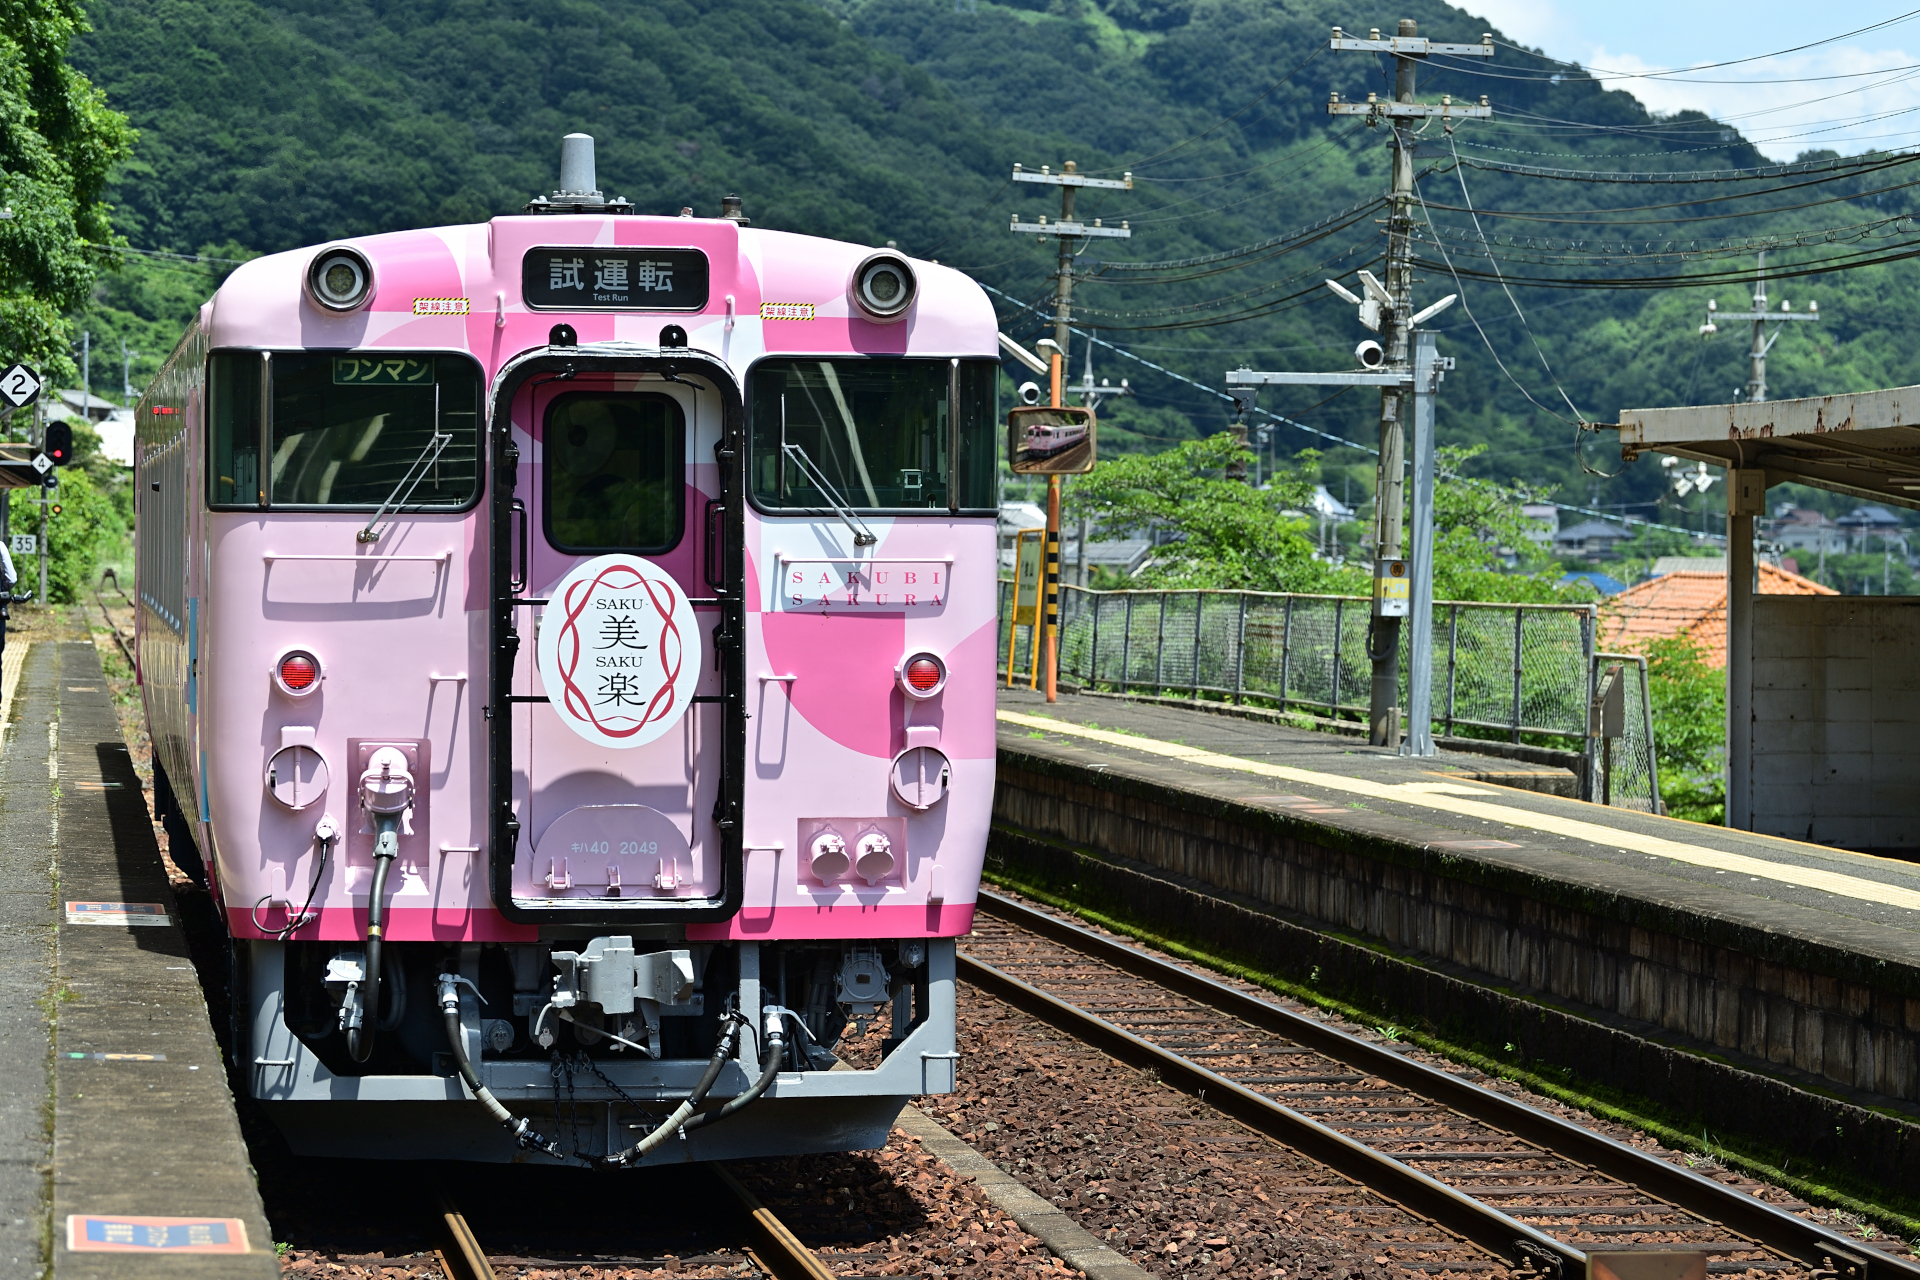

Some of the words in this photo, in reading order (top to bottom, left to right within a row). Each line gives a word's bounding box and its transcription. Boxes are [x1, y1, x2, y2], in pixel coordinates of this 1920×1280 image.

[549, 258, 674, 293] 試運転
[593, 293, 611, 301] Test
[612, 293, 629, 302] Run
[418, 301, 464, 312] 架線注意
[765, 306, 809, 317] 架線注意
[338, 359, 429, 382] ワンマン
[11, 374, 27, 395] 2
[38, 458, 46, 468] 4
[15, 537, 33, 551] 35
[792, 571, 940, 584] SAKUBI
[1390, 583, 1405, 594] JR
[596, 598, 644, 610] SAKU
[792, 593, 943, 606] SAKURA
[592, 614, 649, 650] 美
[595, 656, 643, 668] SAKU
[593, 672, 647, 707] 楽
[571, 841, 609, 854] キハ40
[619, 841, 658, 855] 2049
